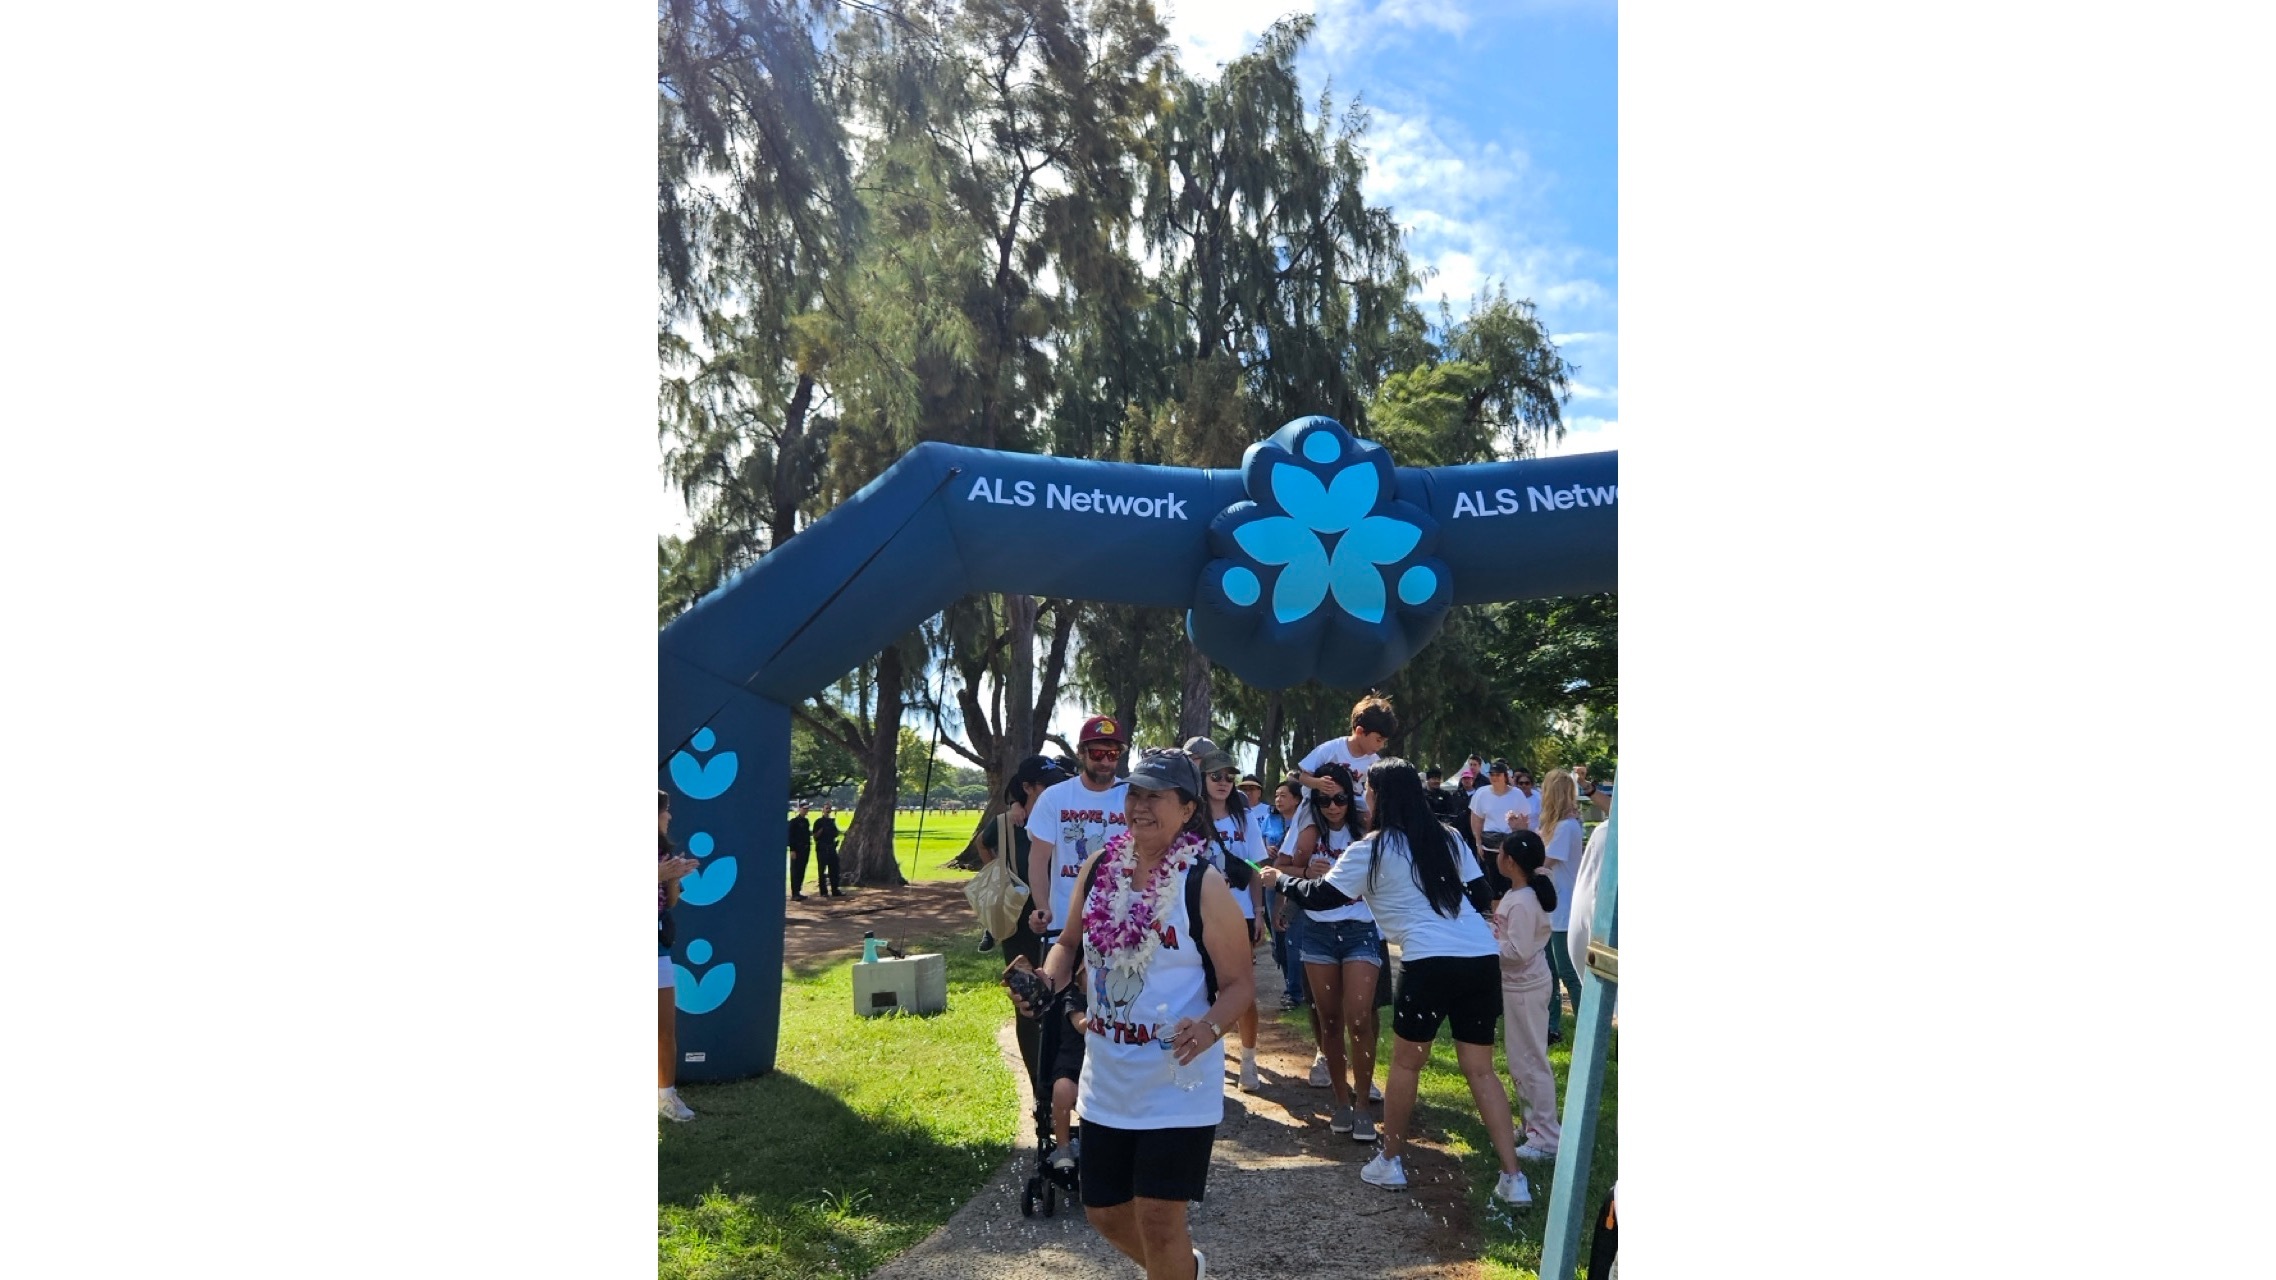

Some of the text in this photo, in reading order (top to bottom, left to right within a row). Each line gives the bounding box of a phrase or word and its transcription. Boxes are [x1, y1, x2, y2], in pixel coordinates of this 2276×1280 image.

[967, 476, 1188, 520] ALS Network
[1452, 484, 1618, 519] ALS Netw
[1113, 1021, 1155, 1044] TEA
